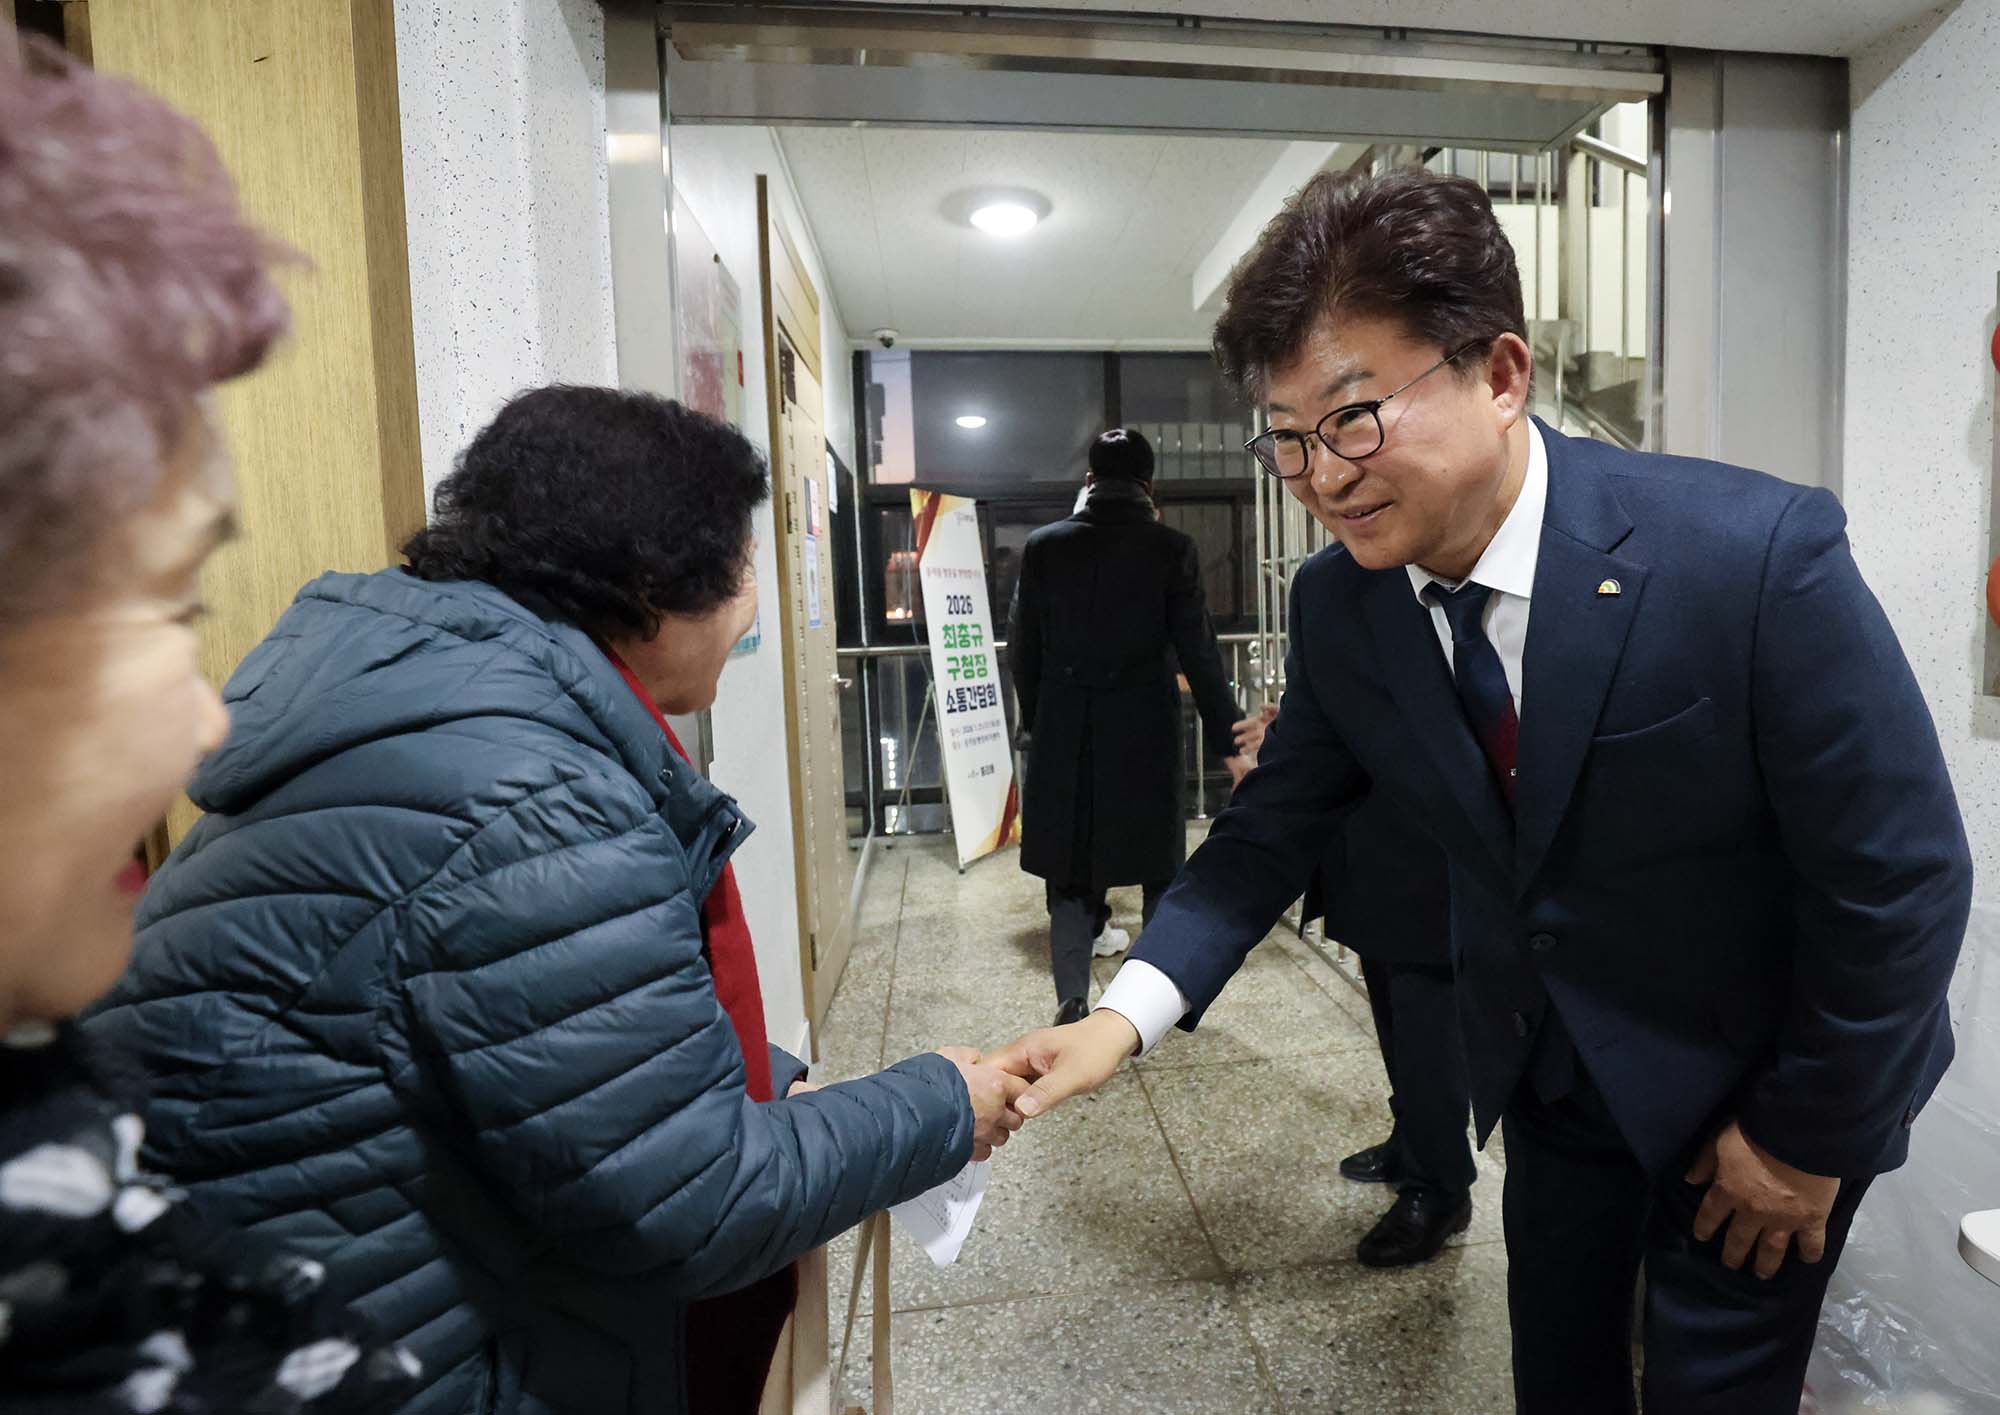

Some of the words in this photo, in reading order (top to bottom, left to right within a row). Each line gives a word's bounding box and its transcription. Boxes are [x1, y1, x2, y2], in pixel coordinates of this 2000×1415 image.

[946, 595, 973, 615] 2026
[942, 623, 983, 649] 최충규
[946, 653, 988, 681] 구청장
[946, 683, 998, 714] 소통간담회
